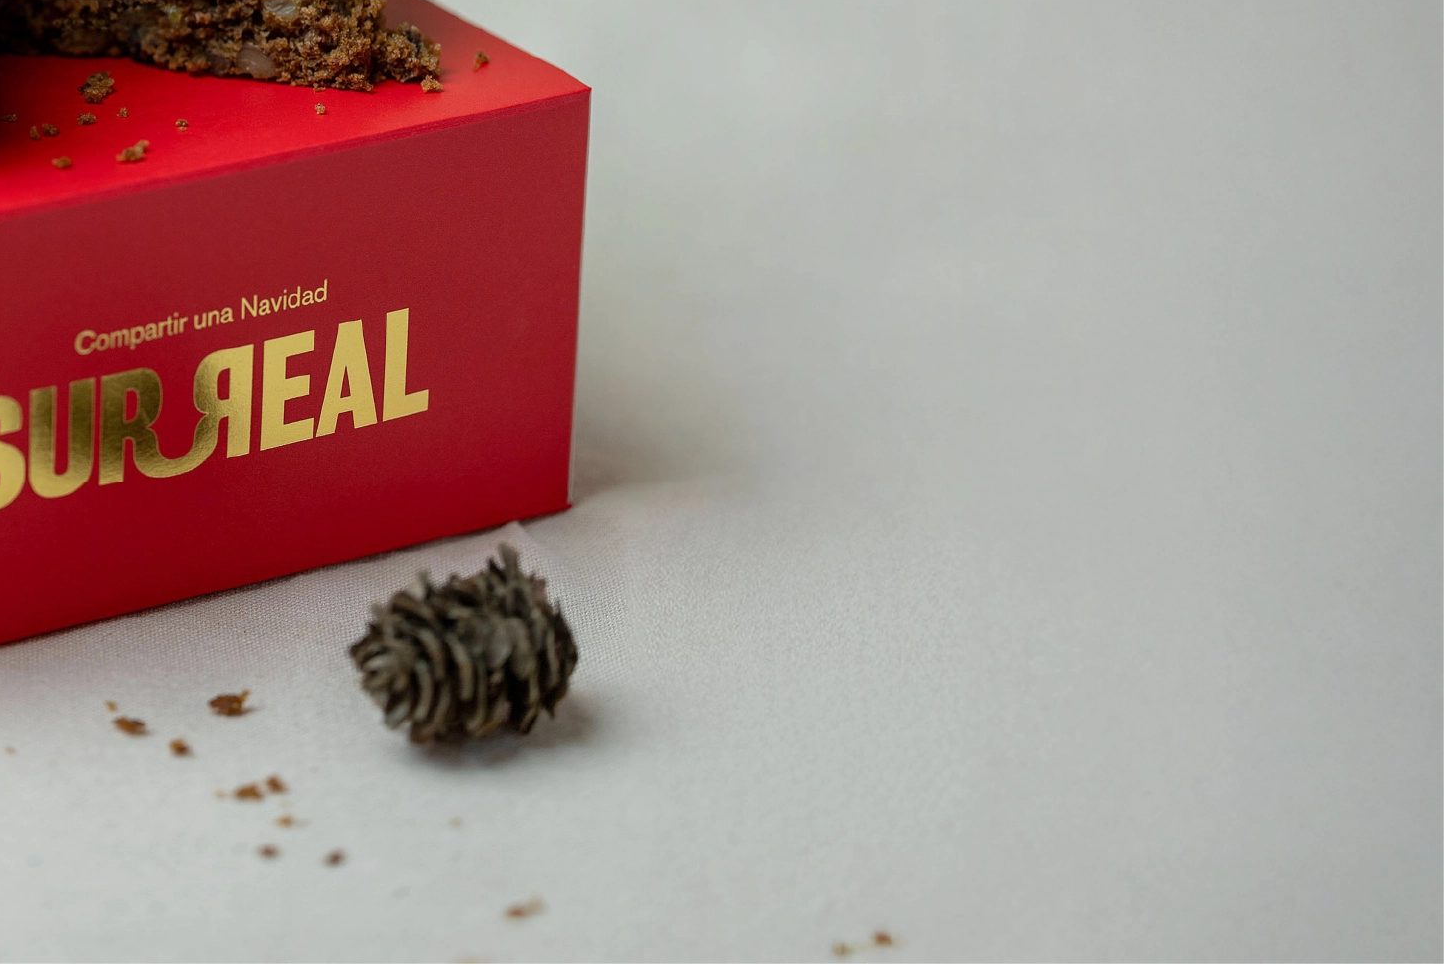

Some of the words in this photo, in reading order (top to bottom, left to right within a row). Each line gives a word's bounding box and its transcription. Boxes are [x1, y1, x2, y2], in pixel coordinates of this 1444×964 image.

[74, 311, 188, 356] Compartir
[193, 306, 234, 331] una
[241, 278, 328, 320] Navidad
